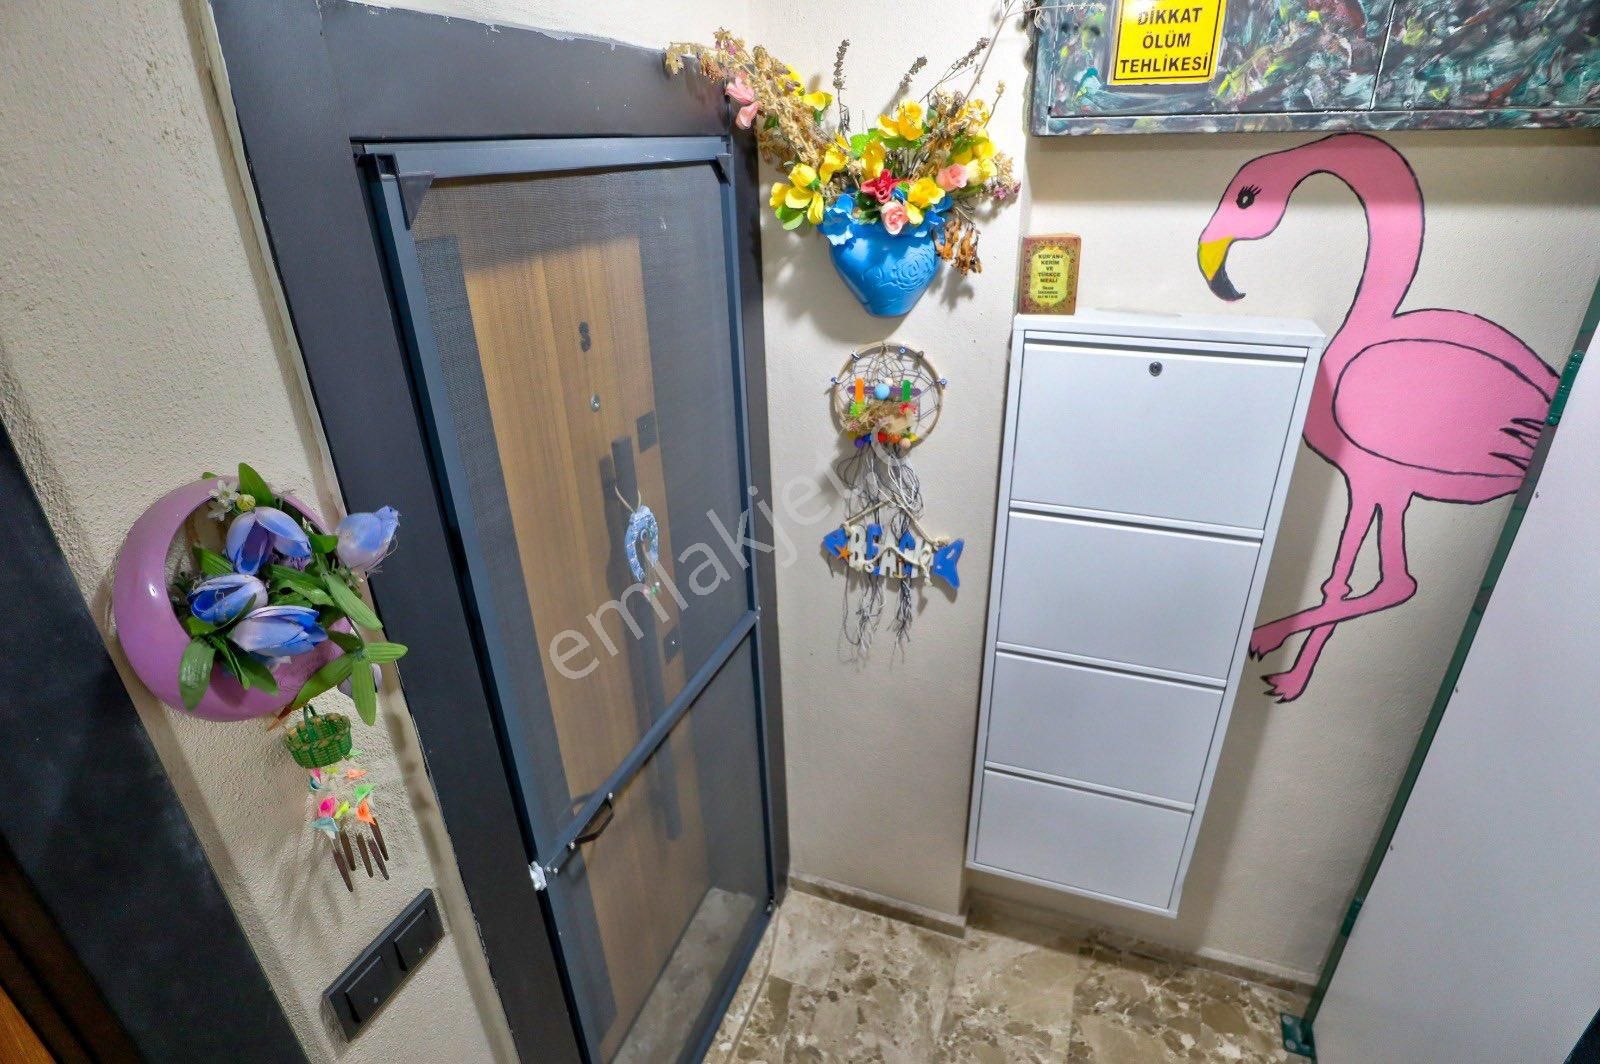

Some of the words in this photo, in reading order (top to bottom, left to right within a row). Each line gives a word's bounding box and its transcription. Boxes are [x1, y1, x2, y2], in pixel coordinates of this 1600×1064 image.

[1137, 6, 1203, 26] DİKKAT
[1142, 29, 1192, 49] ÖLÜM
[1120, 52, 1209, 73] TEHLİKESİ
